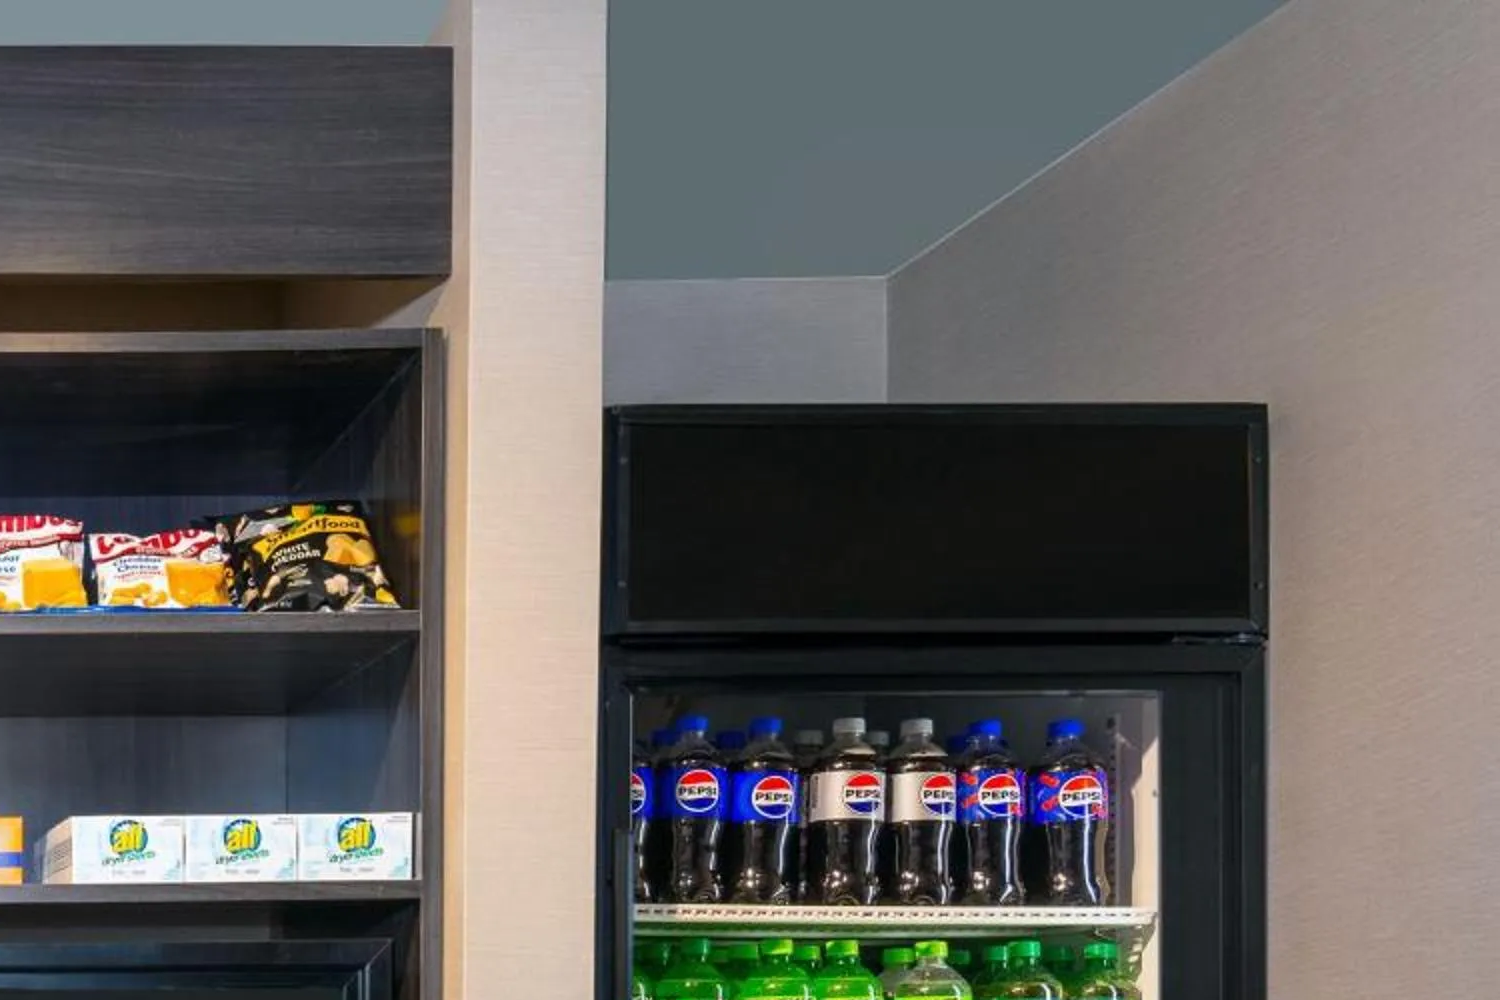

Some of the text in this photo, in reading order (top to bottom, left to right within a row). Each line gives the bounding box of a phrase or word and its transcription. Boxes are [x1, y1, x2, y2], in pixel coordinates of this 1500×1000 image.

[112, 822, 143, 854] all
[226, 820, 258, 853] all
[341, 821, 371, 851] all
